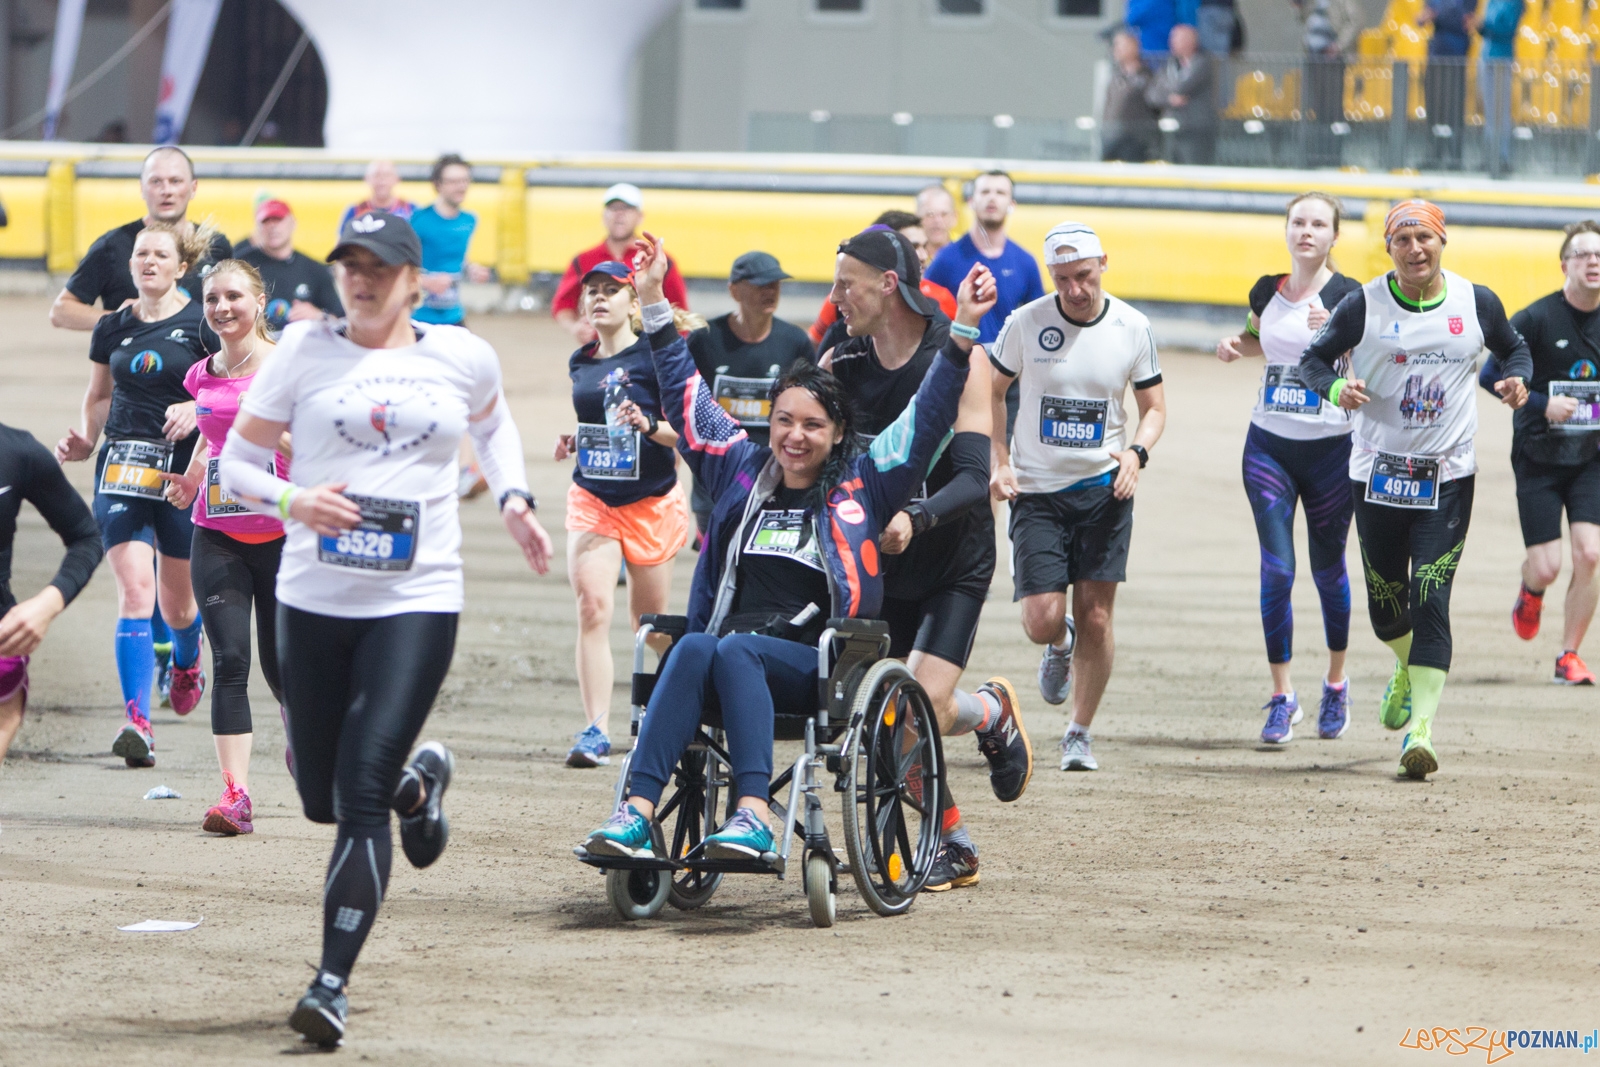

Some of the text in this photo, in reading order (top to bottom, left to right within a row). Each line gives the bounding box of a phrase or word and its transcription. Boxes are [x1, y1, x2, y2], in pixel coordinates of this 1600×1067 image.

[1043, 333, 1059, 345] PZU
[1271, 387, 1307, 406] 4605
[1051, 421, 1095, 440] 10559
[1384, 477, 1421, 497] 4970
[335, 529, 394, 559] 5526
